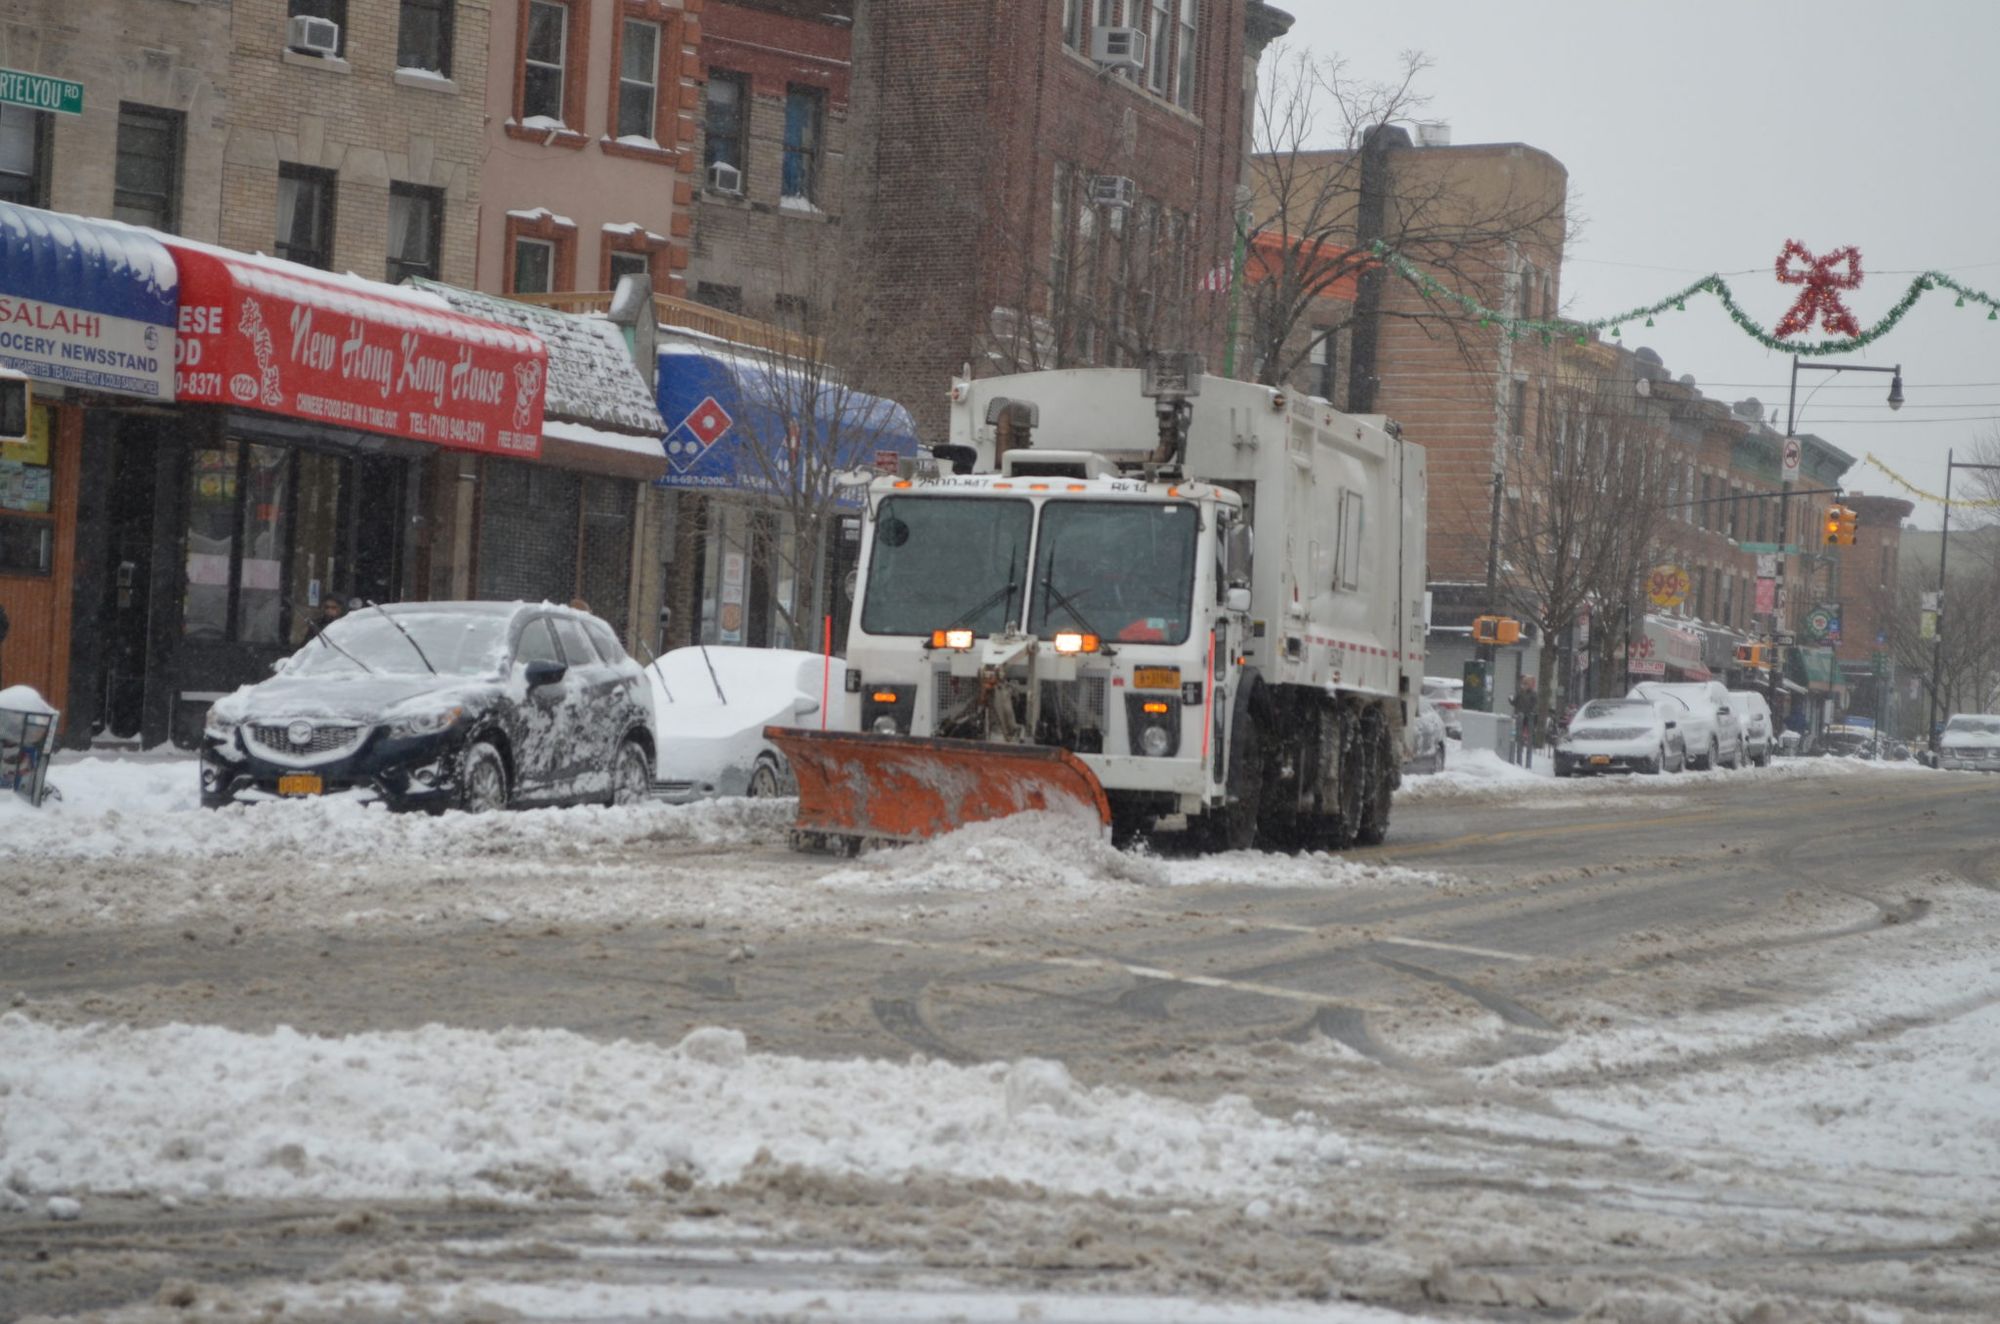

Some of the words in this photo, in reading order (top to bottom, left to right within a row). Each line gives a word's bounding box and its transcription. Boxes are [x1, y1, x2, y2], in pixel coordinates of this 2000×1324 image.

[64, 84, 79, 99] RD
[1, 331, 56, 355] OCERY
[61, 342, 158, 373] NEWSSTAND
[290, 303, 336, 371] New
[341, 319, 393, 398] Hong
[396, 332, 446, 409] Kong
[451, 343, 504, 405] House
[52, 365, 63, 378] TEA
[64, 367, 87, 384] COFFEE
[87, 372, 100, 385] HOT
[105, 375, 121, 389] COLD
[233, 376, 255, 397] 1222
[297, 392, 324, 416] CHINESE
[324, 398, 341, 418] FOOD
[341, 401, 354, 421] EAT
[368, 406, 384, 427] TAKE
[384, 409, 398, 430] OUT
[428, 413, 449, 440] (718)
[449, 417, 485, 445] 940-8371
[498, 430, 512, 449] FREE
